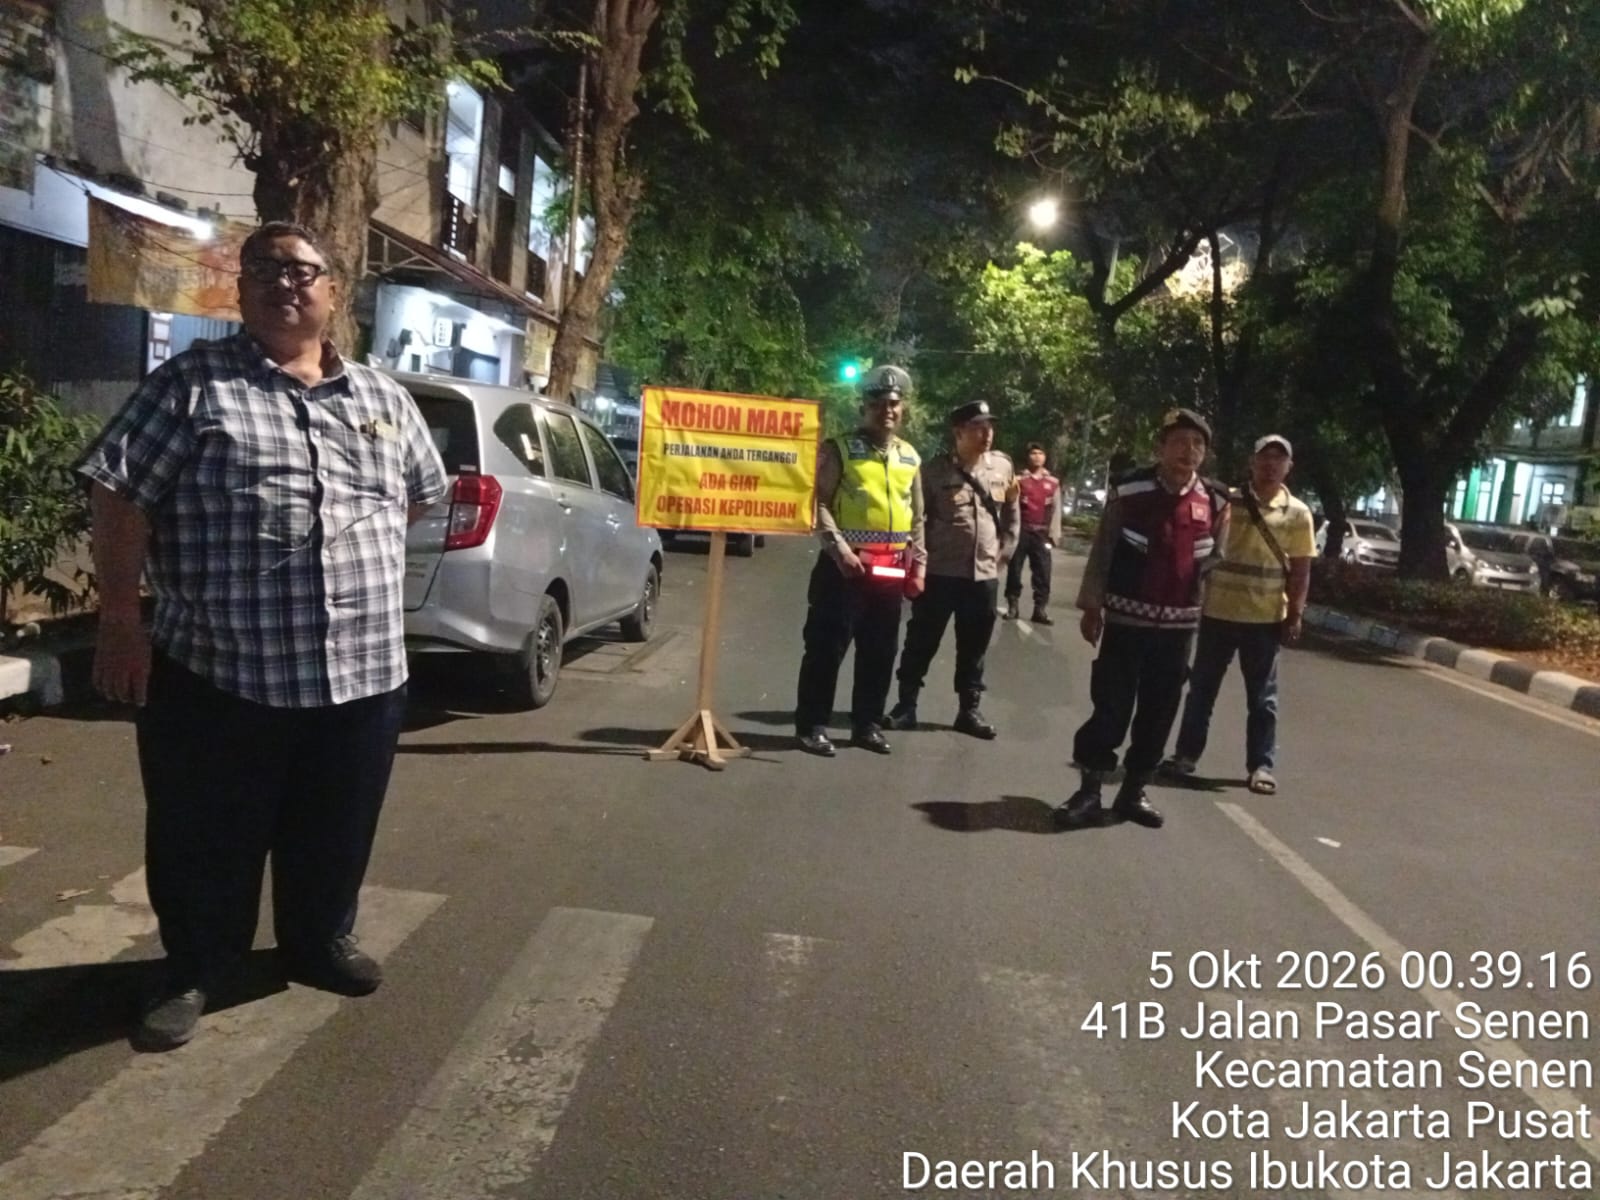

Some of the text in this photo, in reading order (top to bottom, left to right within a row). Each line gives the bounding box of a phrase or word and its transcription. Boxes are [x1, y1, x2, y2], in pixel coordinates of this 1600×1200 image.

[661, 400, 804, 437] MOHON MAAF
[664, 443, 798, 465] PERJALANAN ANDA TERGANGGU
[699, 471, 760, 492] ADA GIAT
[656, 495, 797, 519] OPERASI KEPOLISIAN
